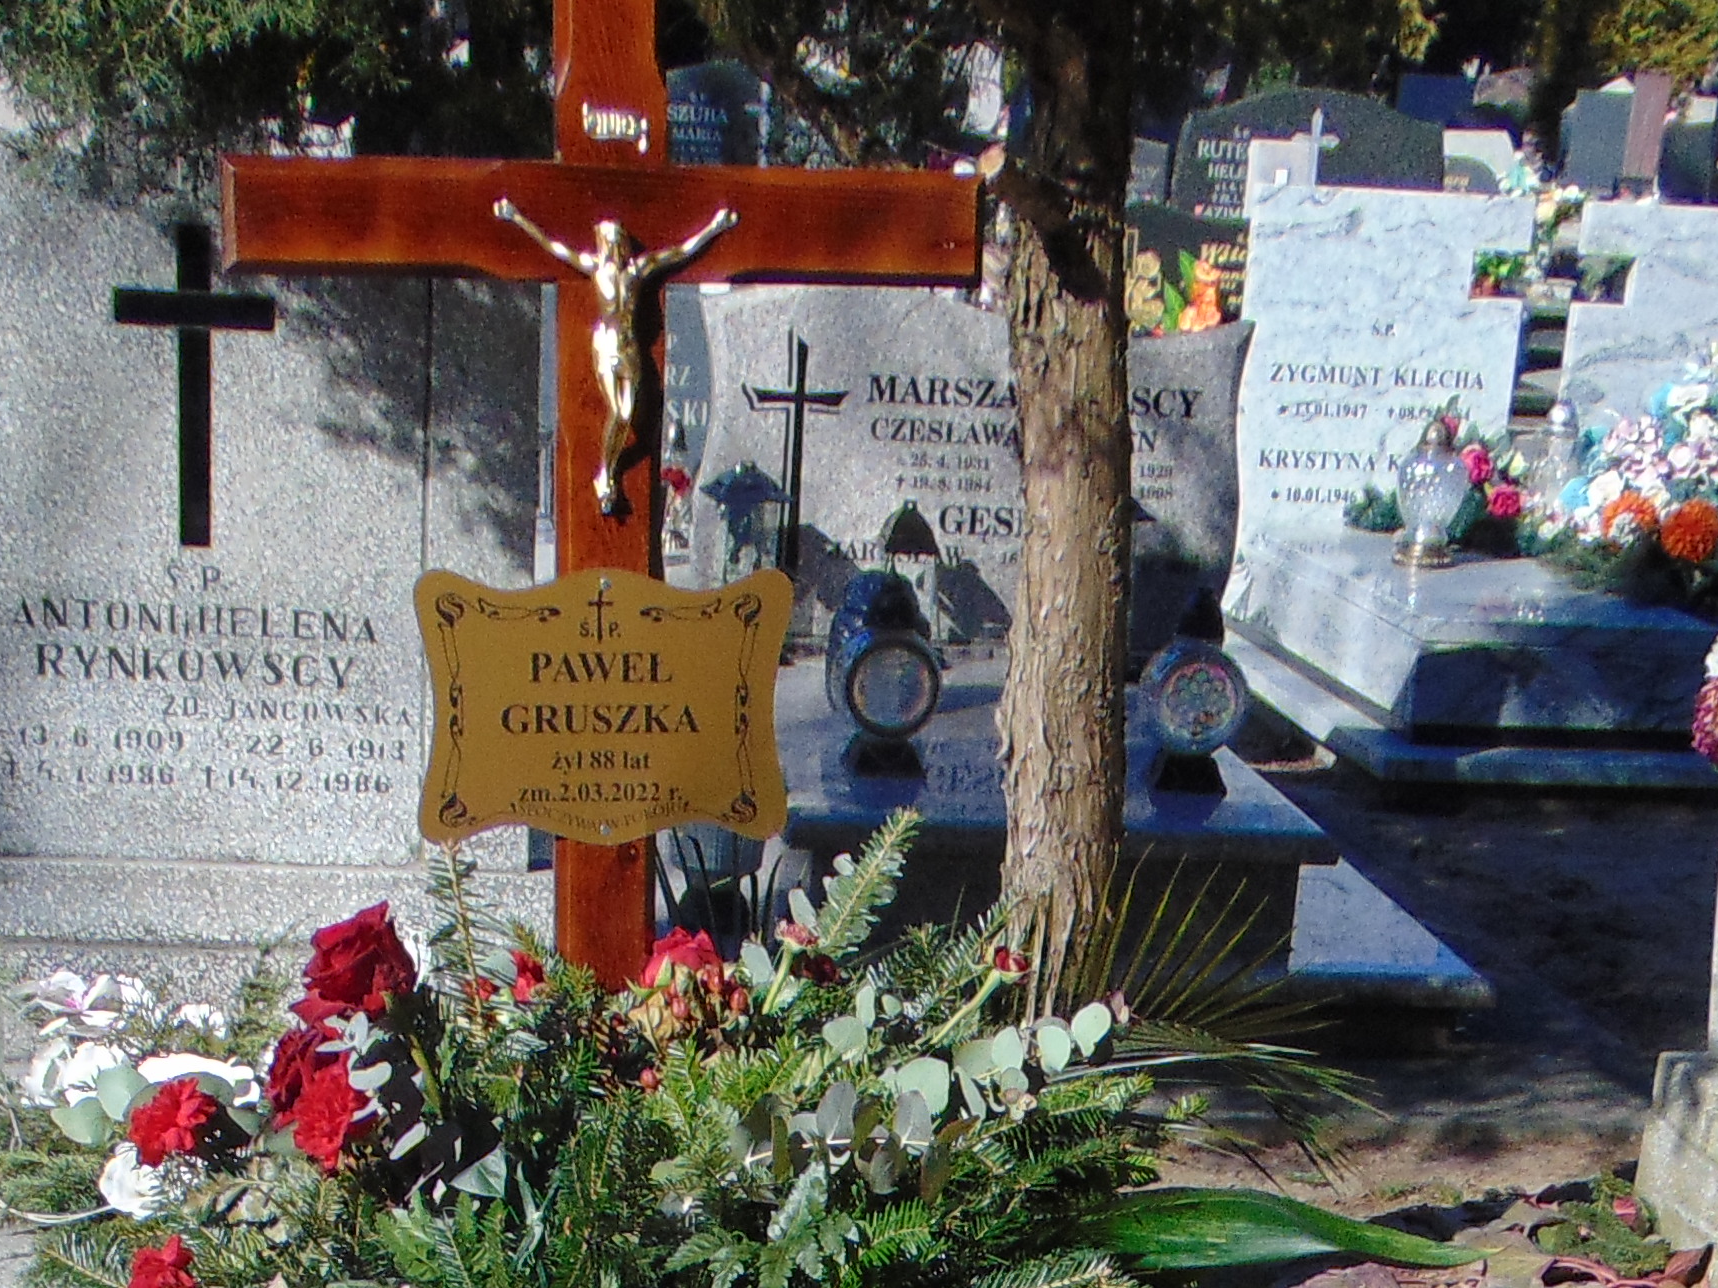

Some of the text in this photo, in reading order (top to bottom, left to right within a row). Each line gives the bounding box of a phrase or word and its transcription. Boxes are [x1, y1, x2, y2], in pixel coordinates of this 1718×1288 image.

[1270, 363, 1484, 390] ZYGMUNT KLECHA
[1259, 449, 1376, 473] KRYSTYNA
[13, 598, 178, 632] ANTONI
[198, 606, 377, 644] HELENA
[35, 642, 355, 690] RYNKOWSCY
[500, 703, 700, 735] GRUSZKA
[589, 751, 616, 771] 88
[623, 751, 650, 771] lat
